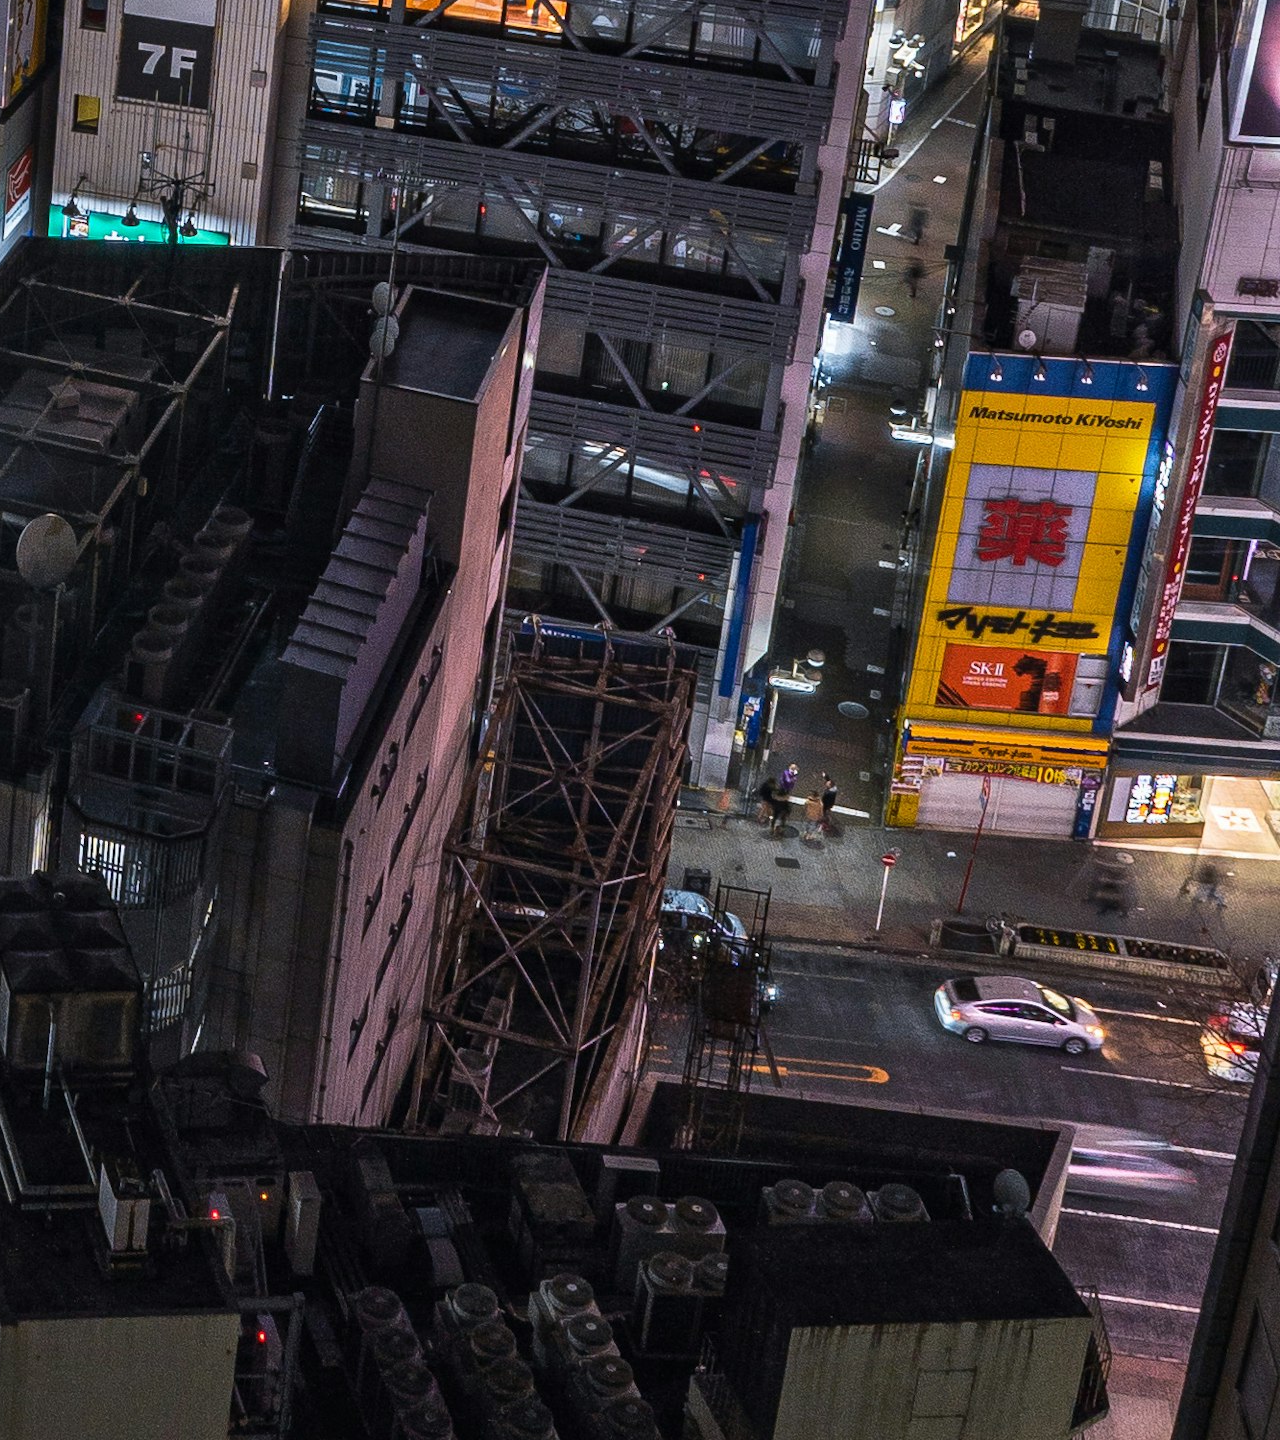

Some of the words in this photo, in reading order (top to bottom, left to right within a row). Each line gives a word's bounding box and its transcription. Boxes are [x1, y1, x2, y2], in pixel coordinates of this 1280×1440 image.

[138, 42, 198, 80] 7F
[851, 206, 868, 251] MIZUHO
[969, 406, 1074, 426] Matsumoto
[1075, 413, 1144, 430] KiYoshi
[975, 498, 1074, 567] 薬
[937, 606, 1100, 643] マツモトキヨシ
[969, 661, 1004, 675] SK-II
